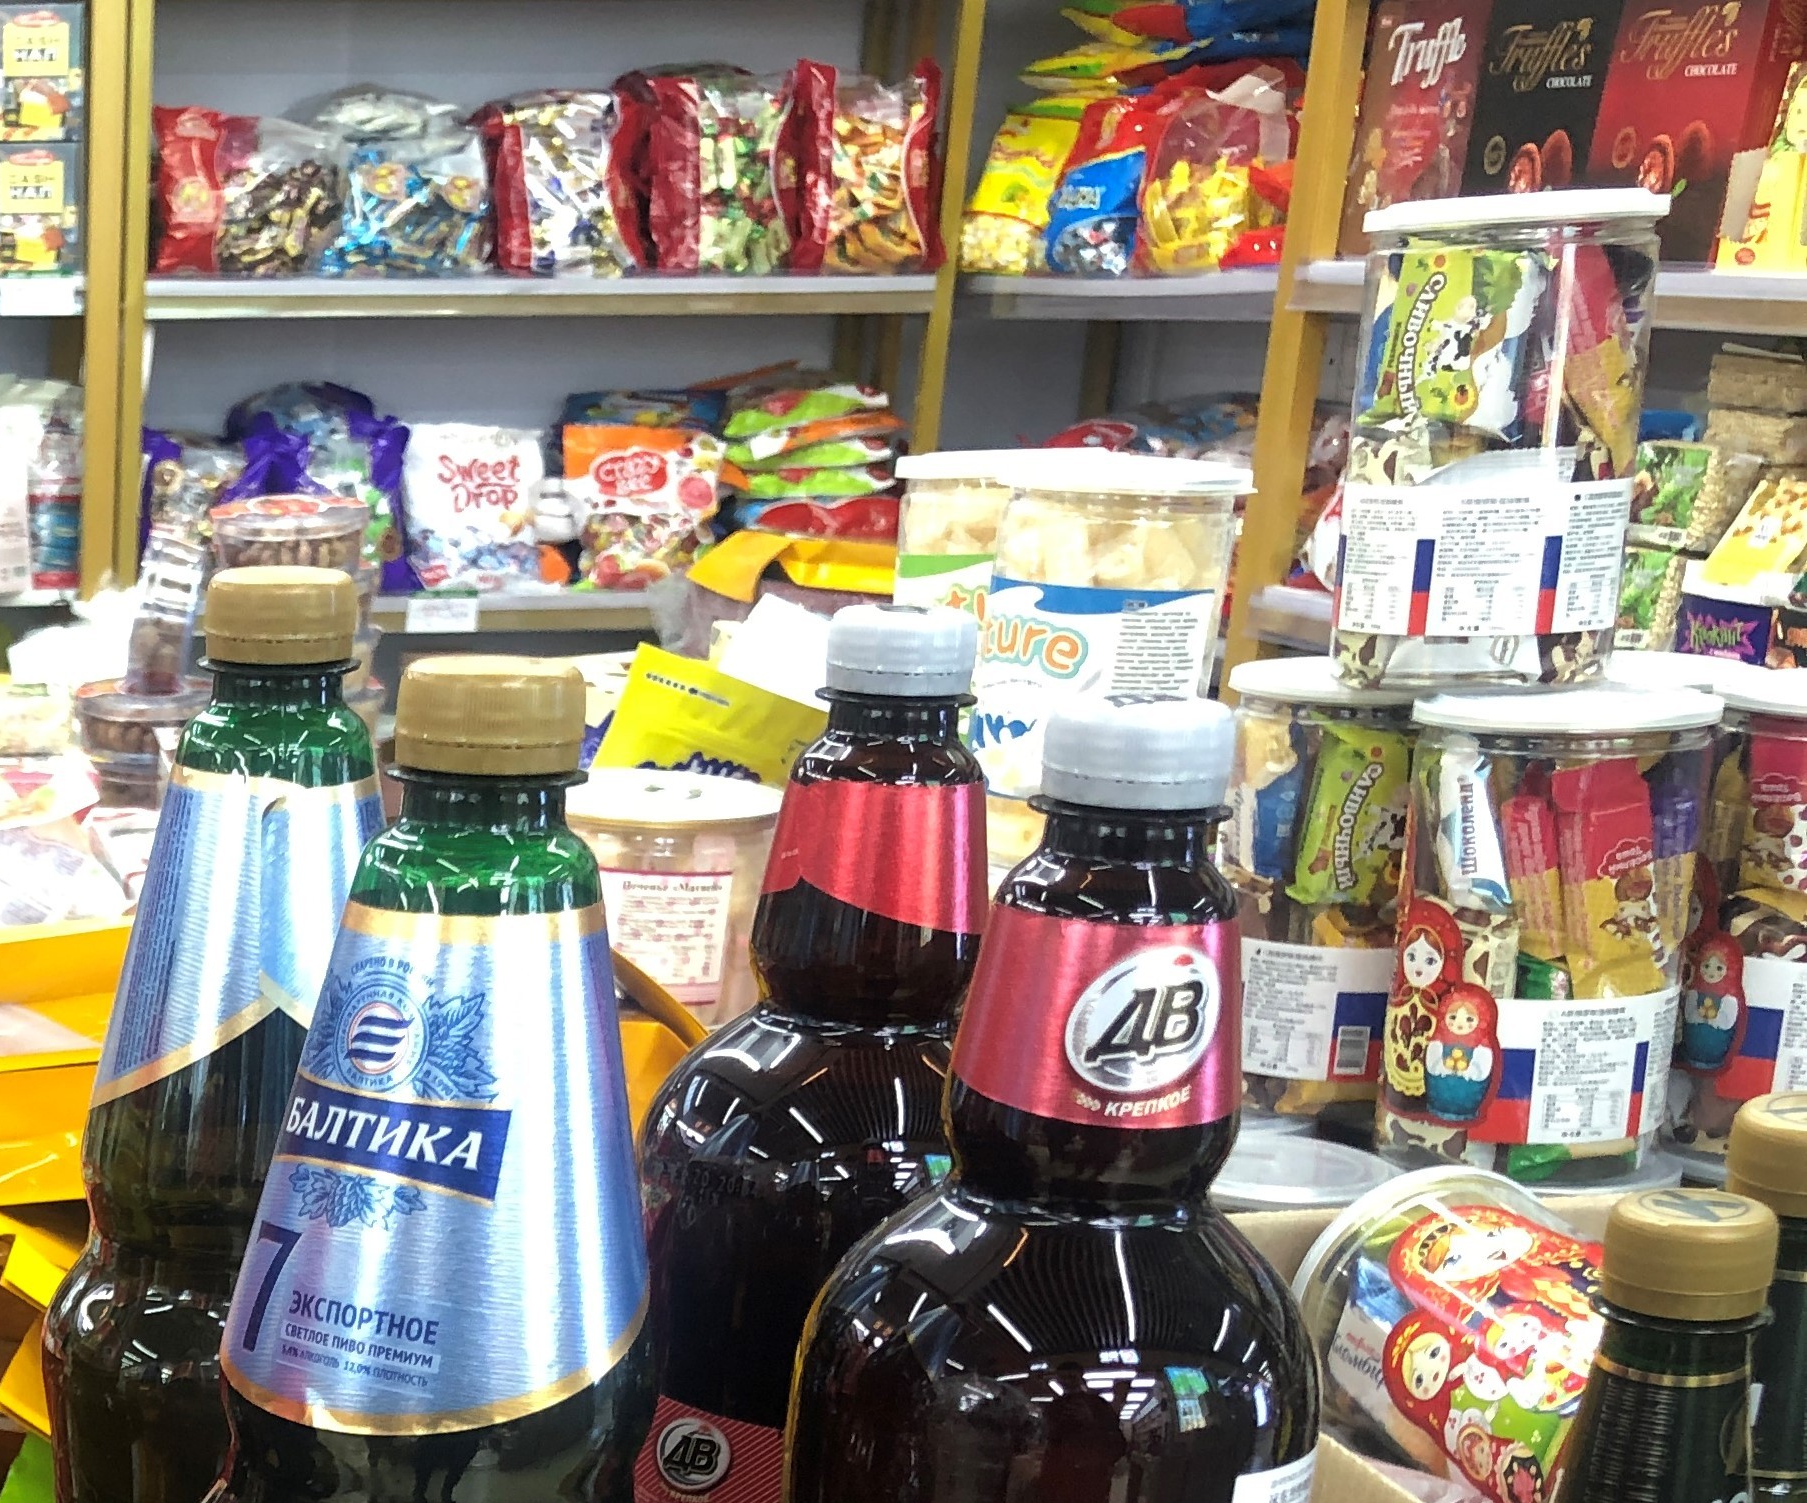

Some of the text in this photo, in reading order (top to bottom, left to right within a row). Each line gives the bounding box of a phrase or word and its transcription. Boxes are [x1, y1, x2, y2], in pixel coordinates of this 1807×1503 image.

[437, 454, 521, 484] Sweet
[450, 482, 519, 513] Drop
[1084, 980, 1210, 1069] ДВ
[1103, 1087, 1193, 1119] КРЕПКОЕ
[287, 1096, 484, 1171] БАЛТИКА
[242, 1219, 304, 1354] 7
[288, 1289, 440, 1346] ЭКСПОРТНОЕ
[285, 1322, 434, 1369] СВЕТЛОЕ ПИВО ПРЕМИУМ
[661, 1433, 721, 1477] ДВ
